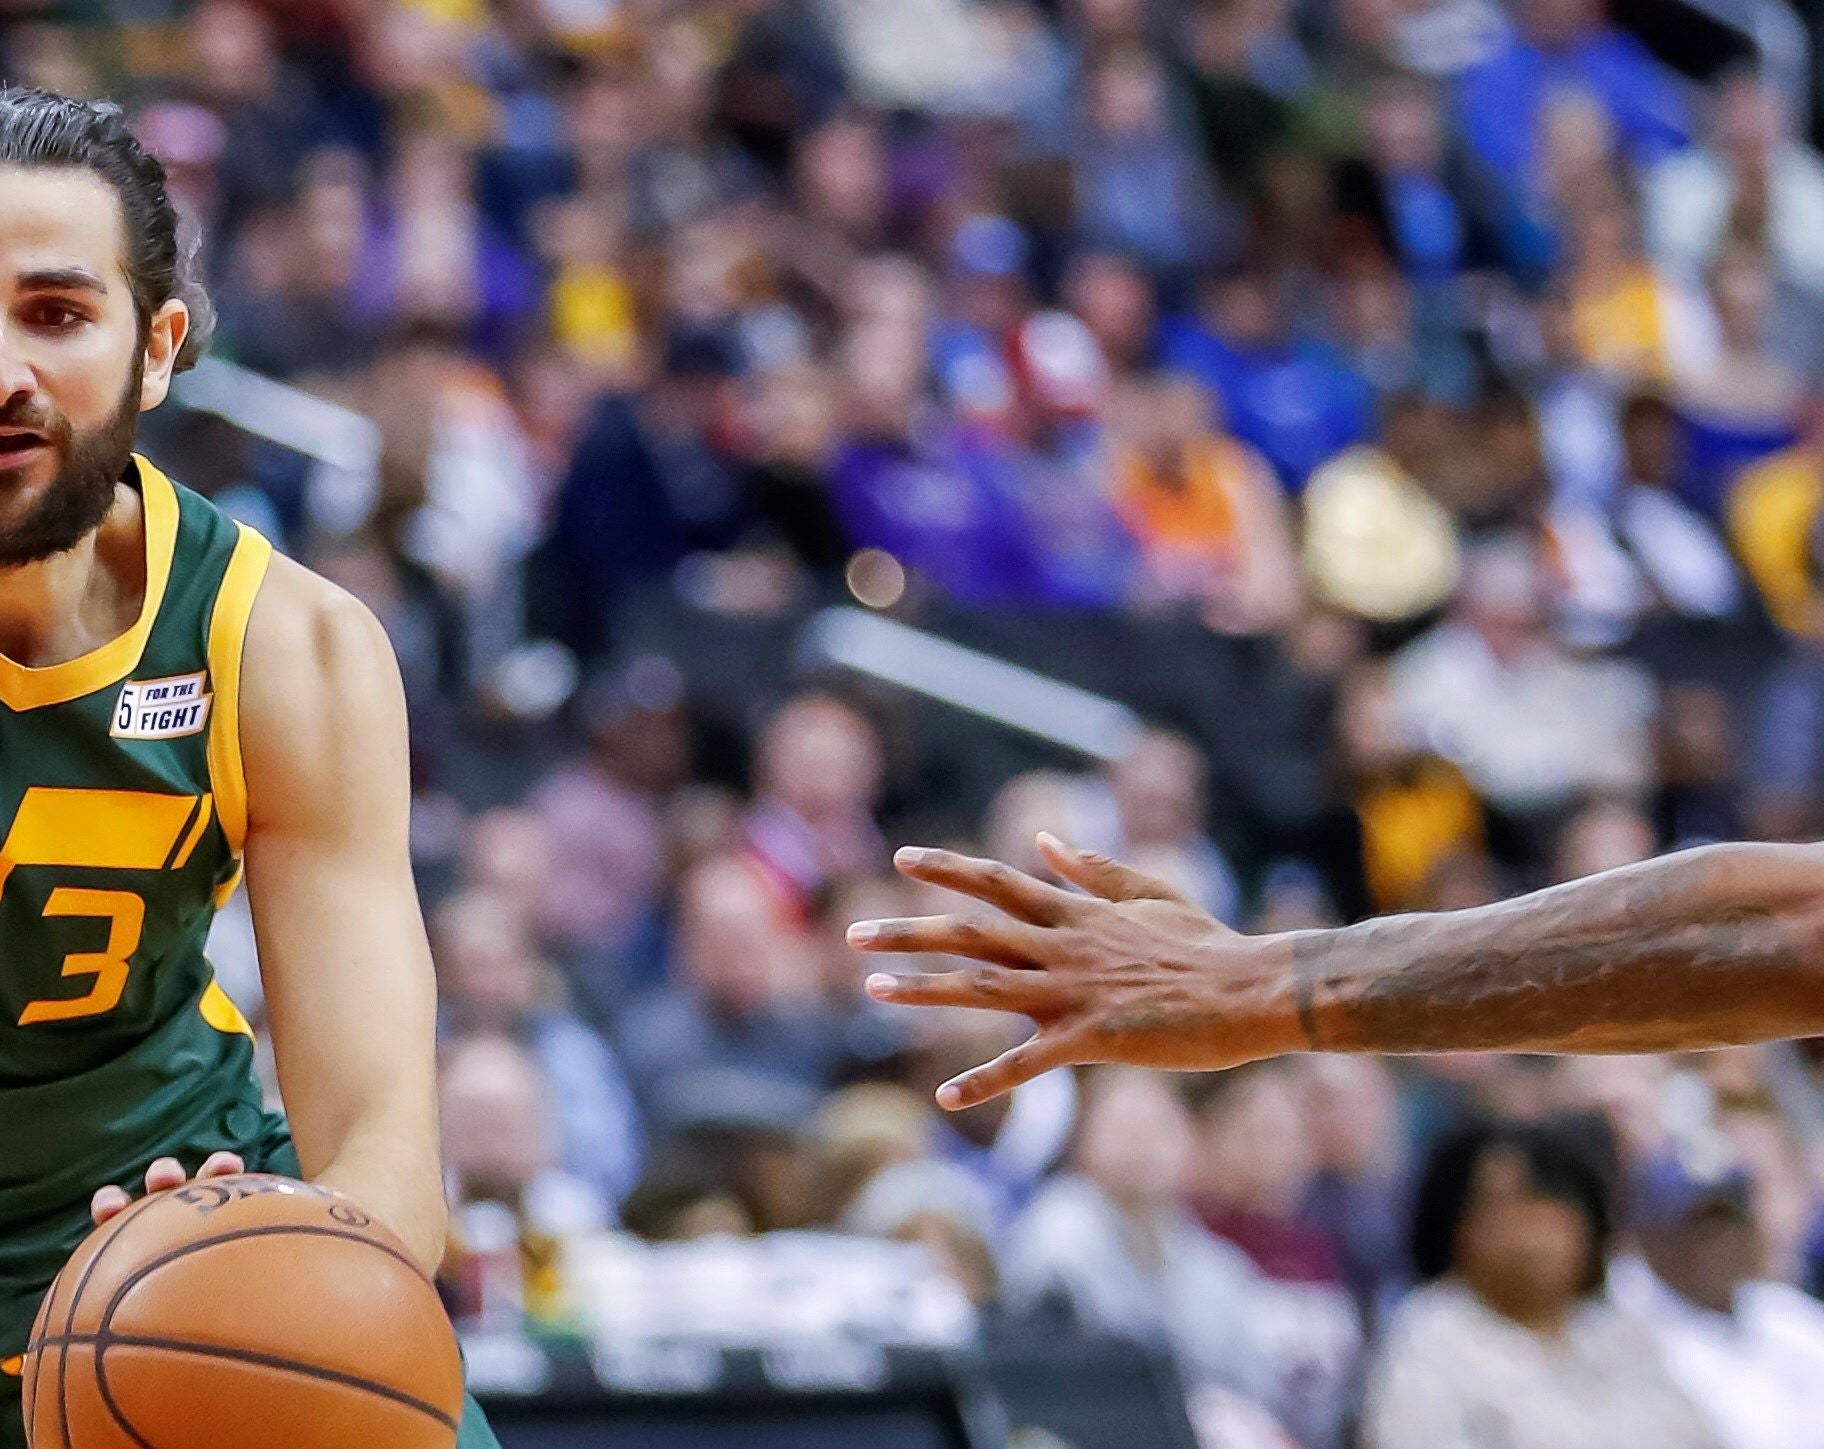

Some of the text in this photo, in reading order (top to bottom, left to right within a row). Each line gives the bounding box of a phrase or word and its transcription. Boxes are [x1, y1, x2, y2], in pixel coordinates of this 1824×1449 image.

[146, 682, 196, 700] FOR THE
[118, 690, 133, 729] 5
[141, 705, 201, 730] FIGHT
[17, 887, 145, 1027] 3
